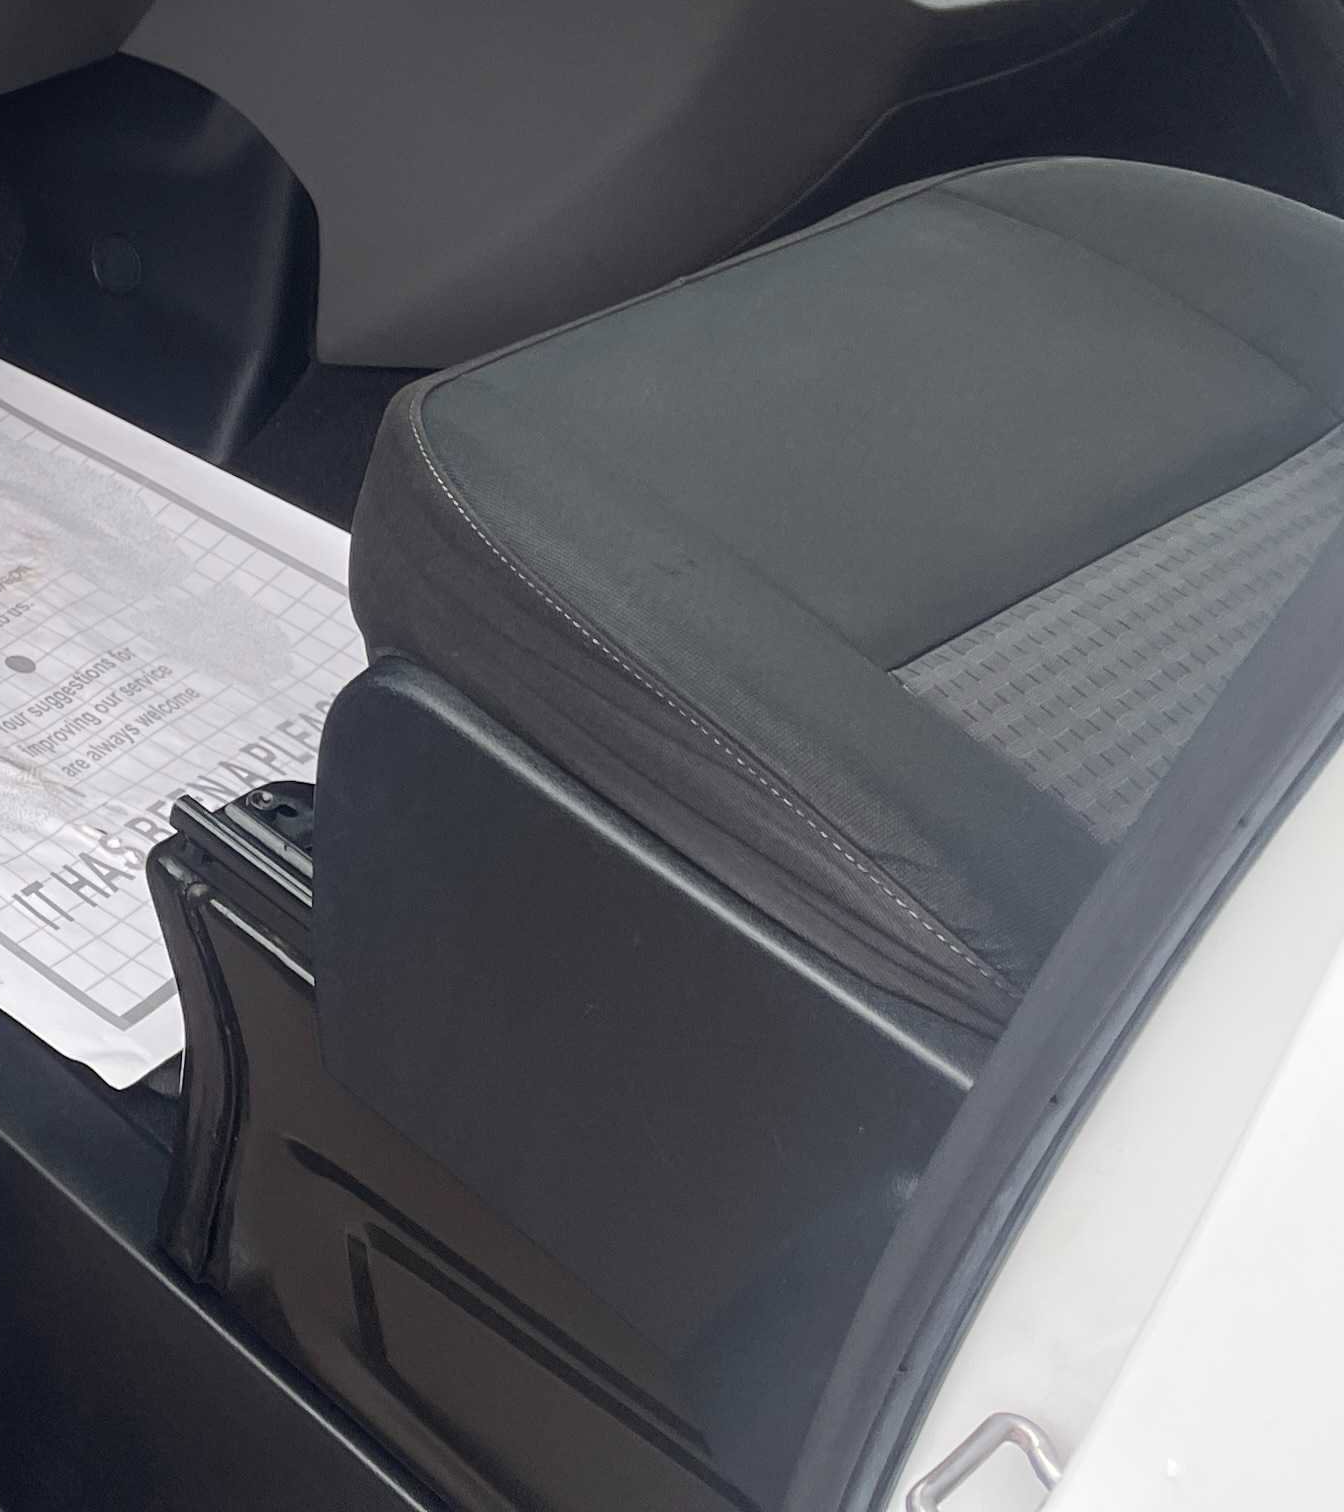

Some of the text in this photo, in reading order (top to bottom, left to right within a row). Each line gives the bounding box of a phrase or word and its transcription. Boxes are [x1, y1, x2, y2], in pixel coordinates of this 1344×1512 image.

[17, 664, 174, 758] improving our service
[27, 650, 118, 718] suggestions
[109, 645, 137, 665] for
[61, 687, 202, 779] are always welcome
[12, 881, 76, 931] IT
[50, 835, 148, 907] HAS
